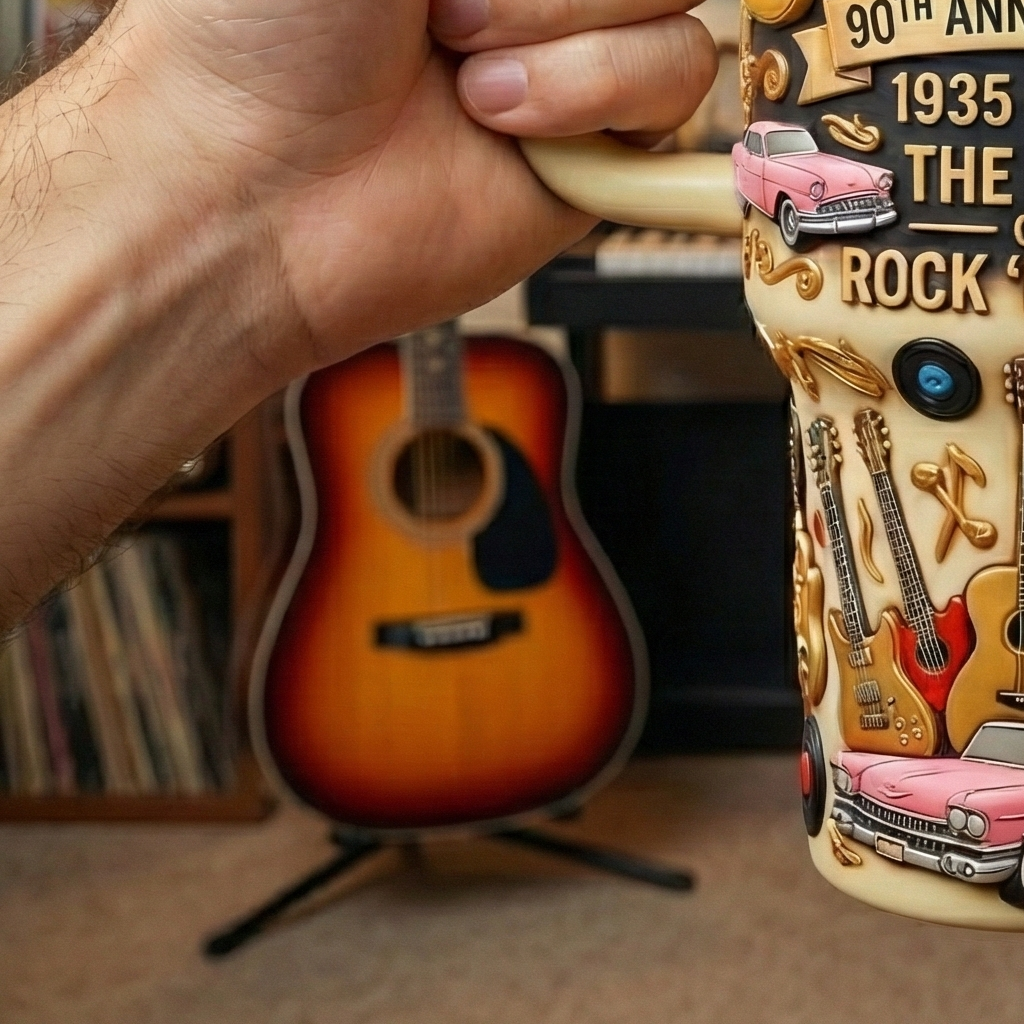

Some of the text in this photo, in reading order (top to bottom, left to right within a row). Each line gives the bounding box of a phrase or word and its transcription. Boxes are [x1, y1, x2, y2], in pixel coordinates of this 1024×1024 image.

[891, 73, 1013, 126] 1935
[904, 145, 1013, 205] THE
[841, 247, 989, 313] ROCK
